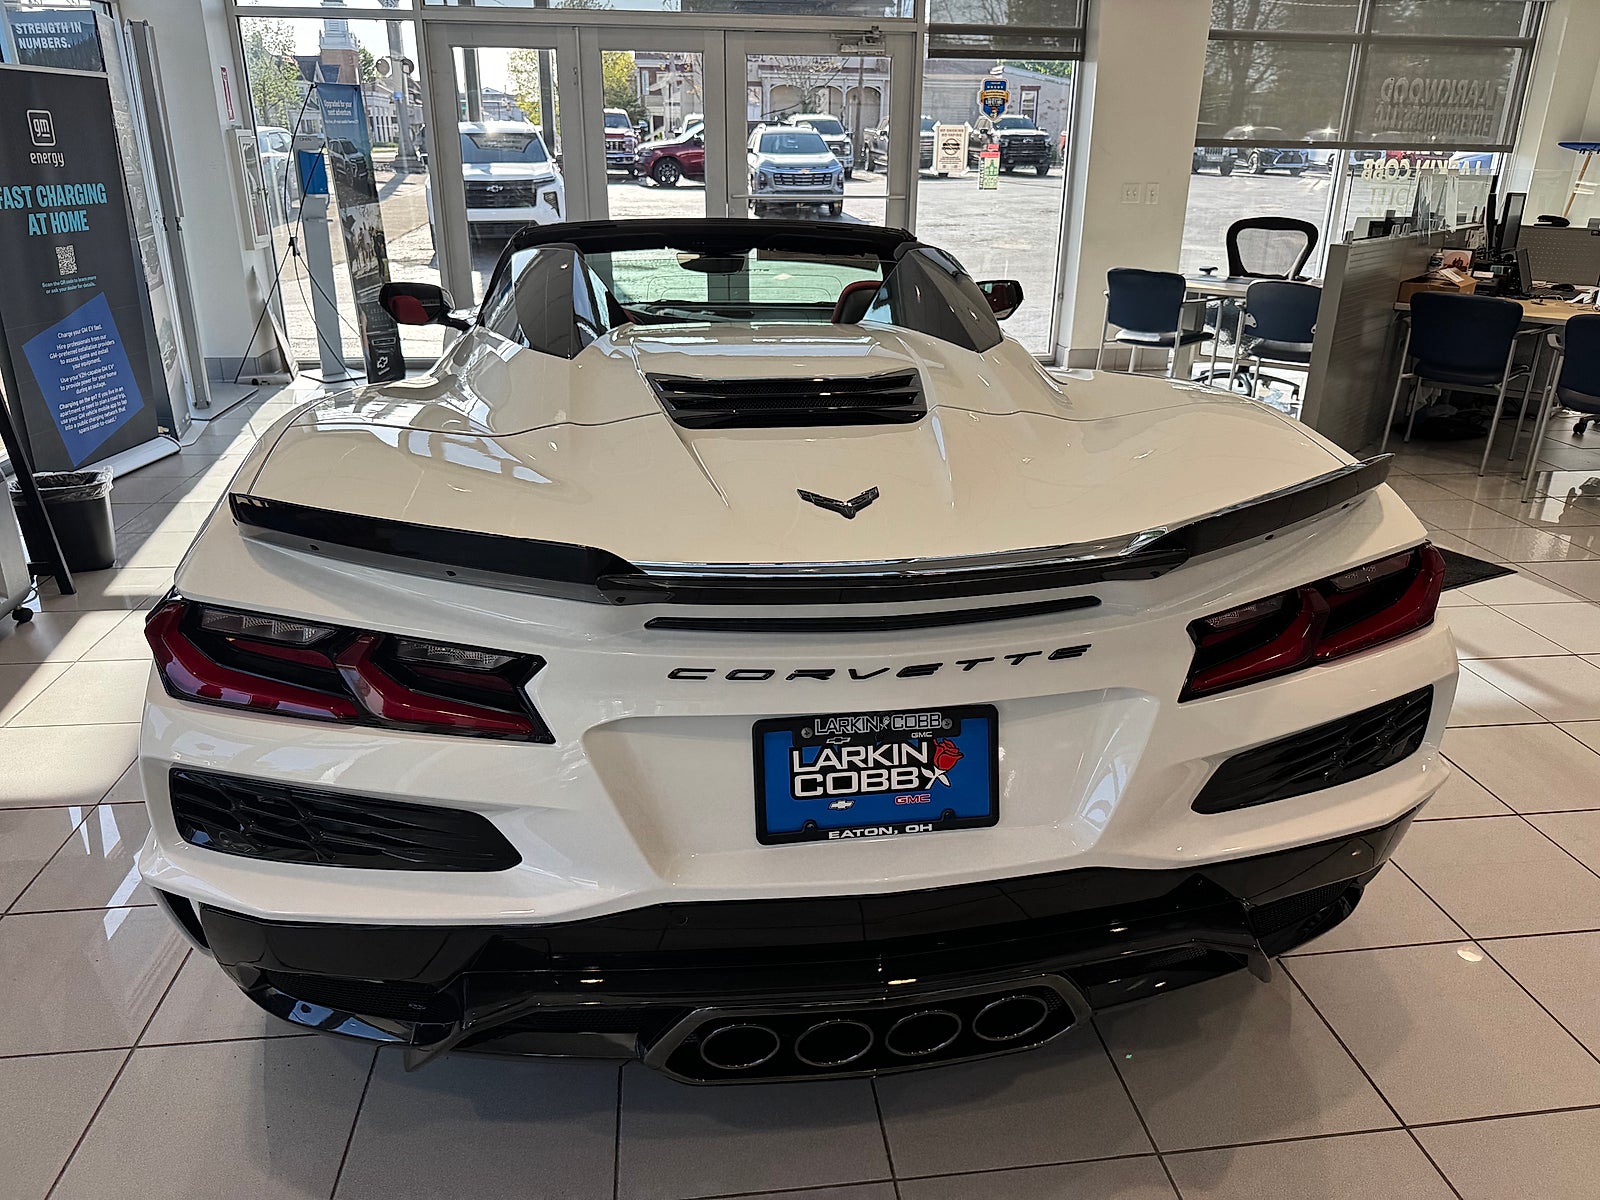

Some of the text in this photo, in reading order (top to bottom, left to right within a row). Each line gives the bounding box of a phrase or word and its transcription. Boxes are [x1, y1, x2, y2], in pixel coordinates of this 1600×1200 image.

[16, 21, 82, 34] STRENGTH IN
[18, 37, 71, 49] NUMBERS.
[33, 119, 51, 137] gm
[30, 152, 65, 167] energy
[36, 183, 107, 207] CHARGING
[28, 210, 90, 236] AT HOME
[666, 643, 1093, 682] CORVETTE
[814, 712, 942, 736] LARKIN COBB
[911, 731, 933, 739] GMC
[792, 741, 928, 773] LARKIN
[794, 766, 920, 797] COBB
[895, 794, 931, 805] GMC
[828, 823, 933, 840] EATON, OH
